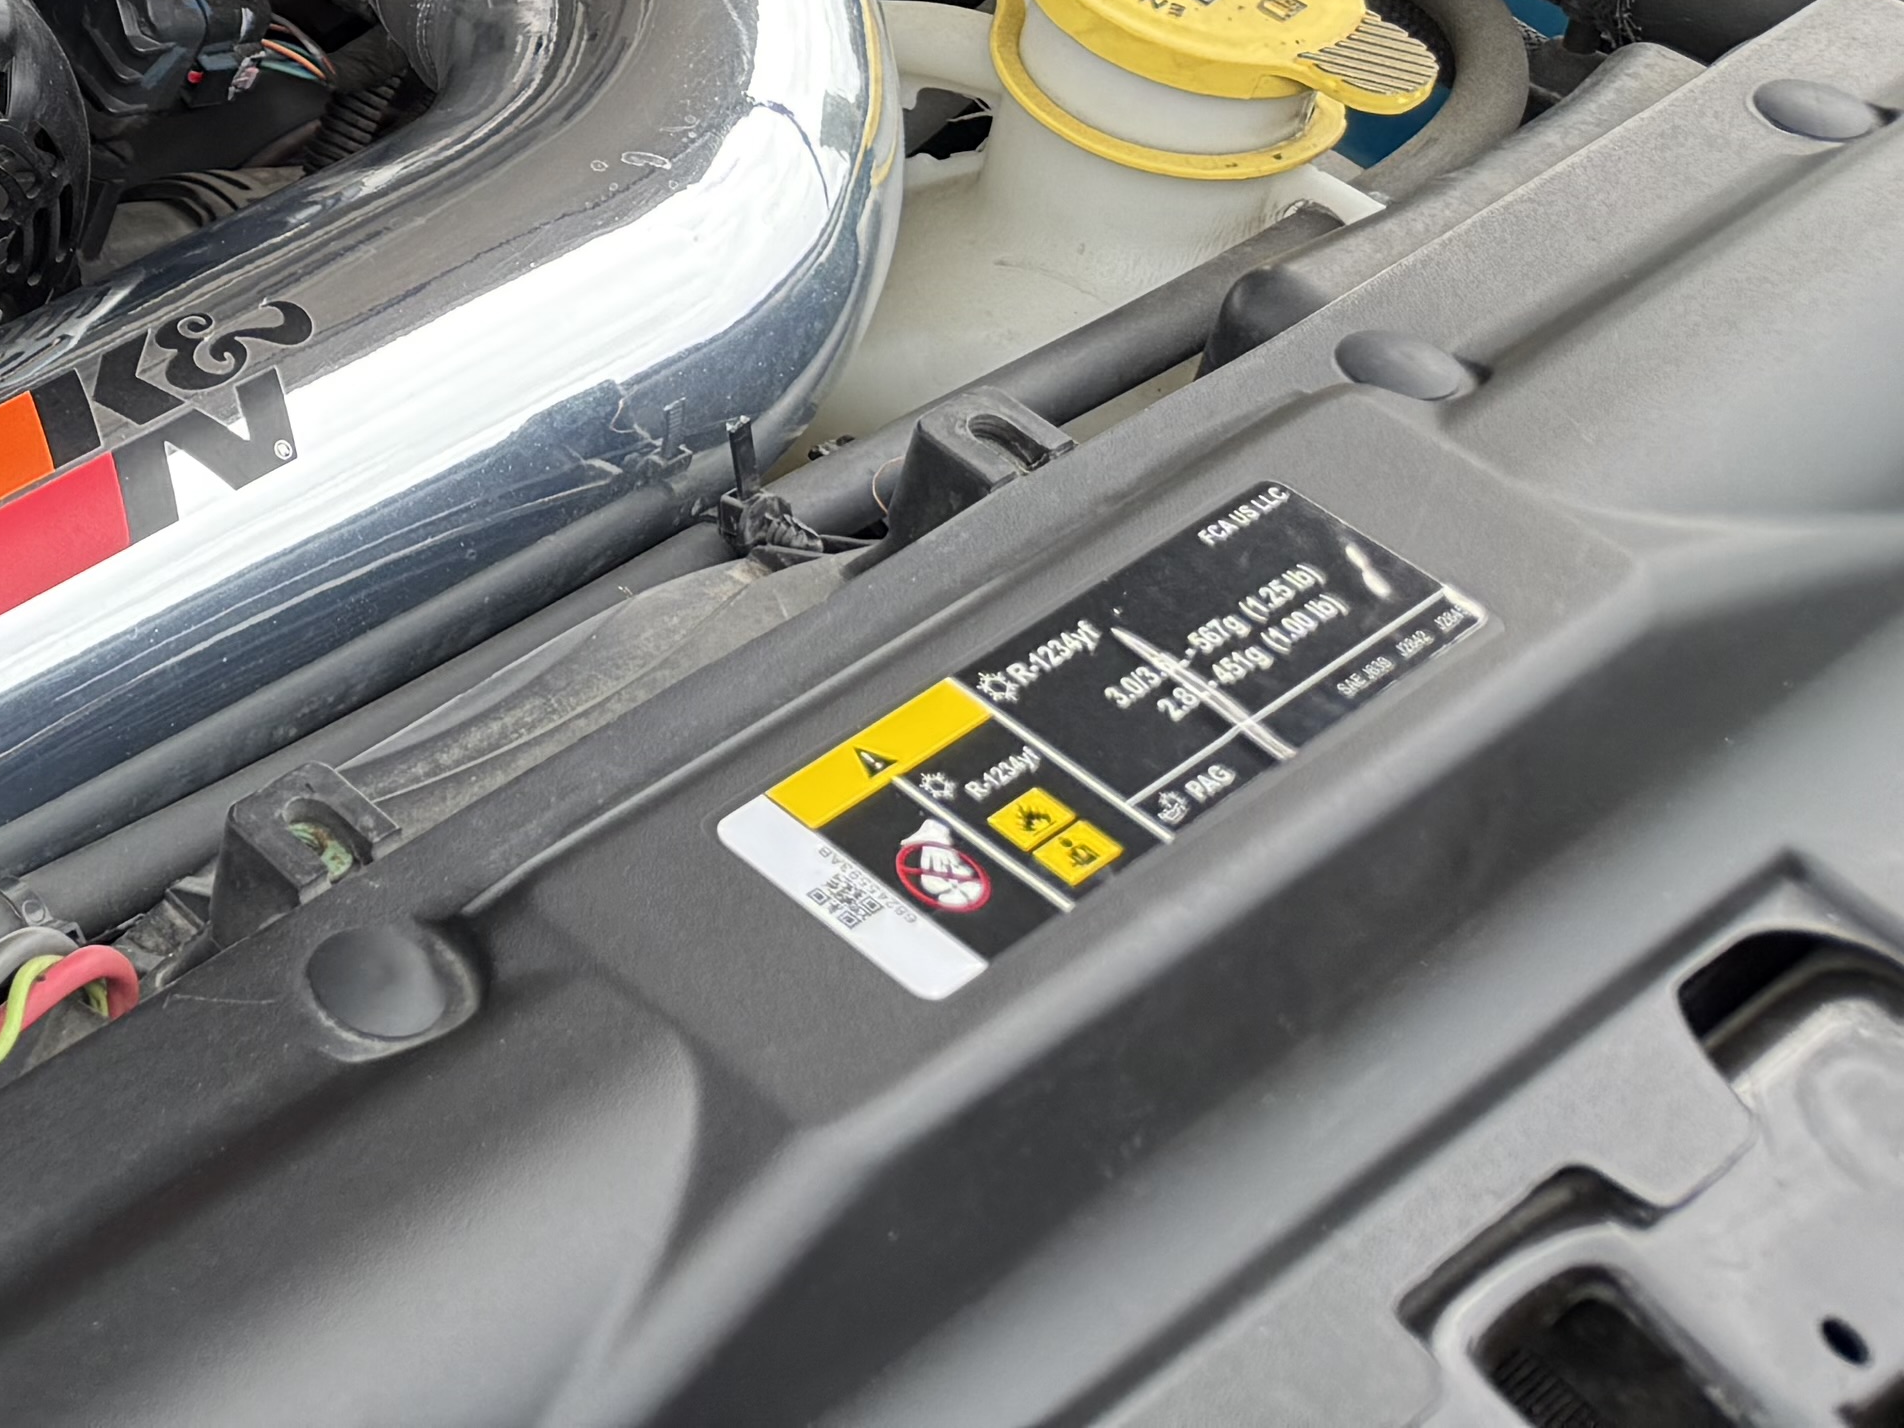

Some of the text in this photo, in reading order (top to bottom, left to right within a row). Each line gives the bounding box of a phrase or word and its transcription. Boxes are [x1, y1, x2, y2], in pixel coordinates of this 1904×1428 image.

[1197, 487, 1291, 549] FCA US LLC
[1006, 619, 1102, 687] R-1234yf
[1185, 764, 1237, 804] PAG
